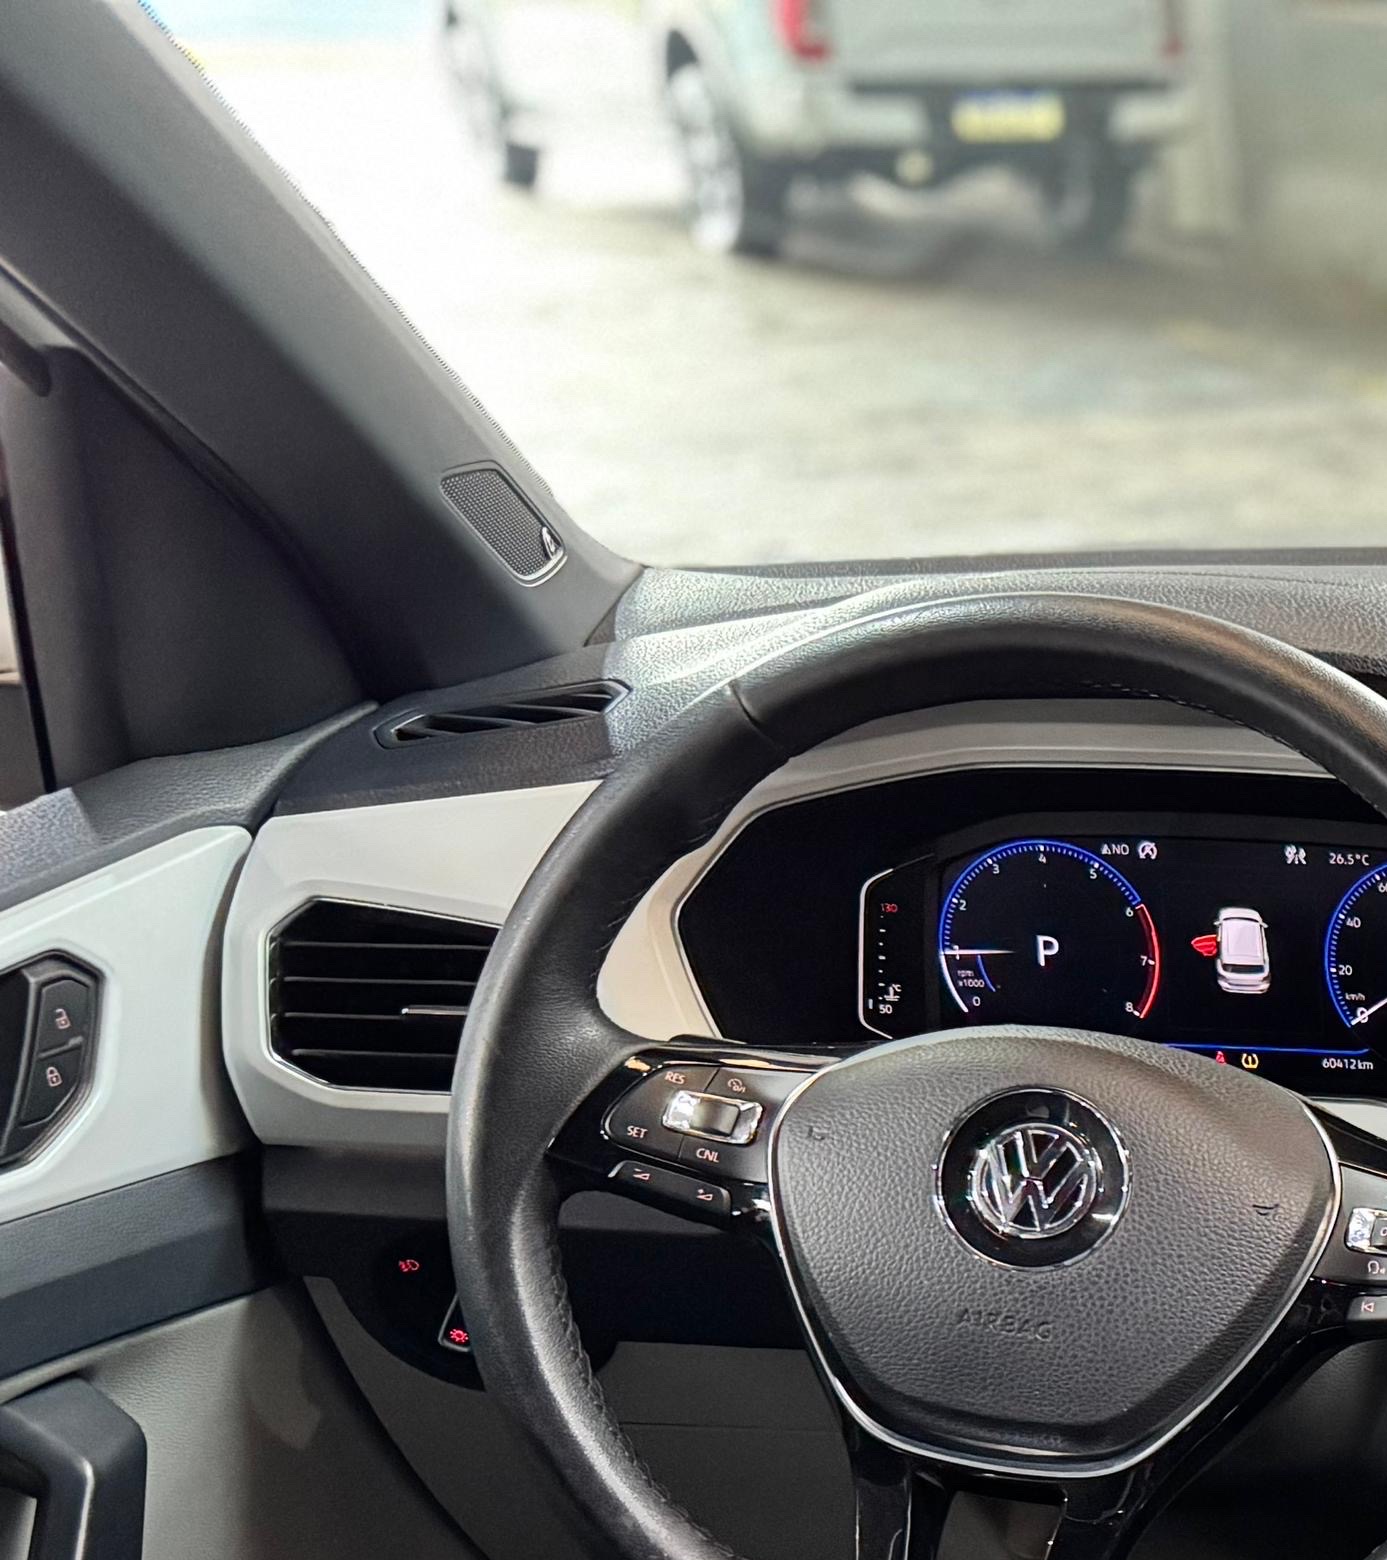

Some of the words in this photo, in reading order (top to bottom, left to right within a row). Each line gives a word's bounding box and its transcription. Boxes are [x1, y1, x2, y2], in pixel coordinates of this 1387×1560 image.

[1039, 854, 1047, 864] 4
[993, 864, 1000, 874] 3
[1090, 869, 1097, 879] 5
[960, 901, 967, 910] 2
[1126, 908, 1134, 917] 6
[1346, 917, 1361, 928] 40
[1036, 935, 1059, 966] P
[1140, 956, 1147, 966] 7
[1338, 965, 1353, 976] 20
[973, 996, 981, 1007] 0
[879, 1004, 893, 1014] 50
[1125, 1002, 1133, 1012] 8
[665, 1071, 685, 1085] RES
[627, 1125, 647, 1139] SET
[696, 1148, 720, 1163] CNL
